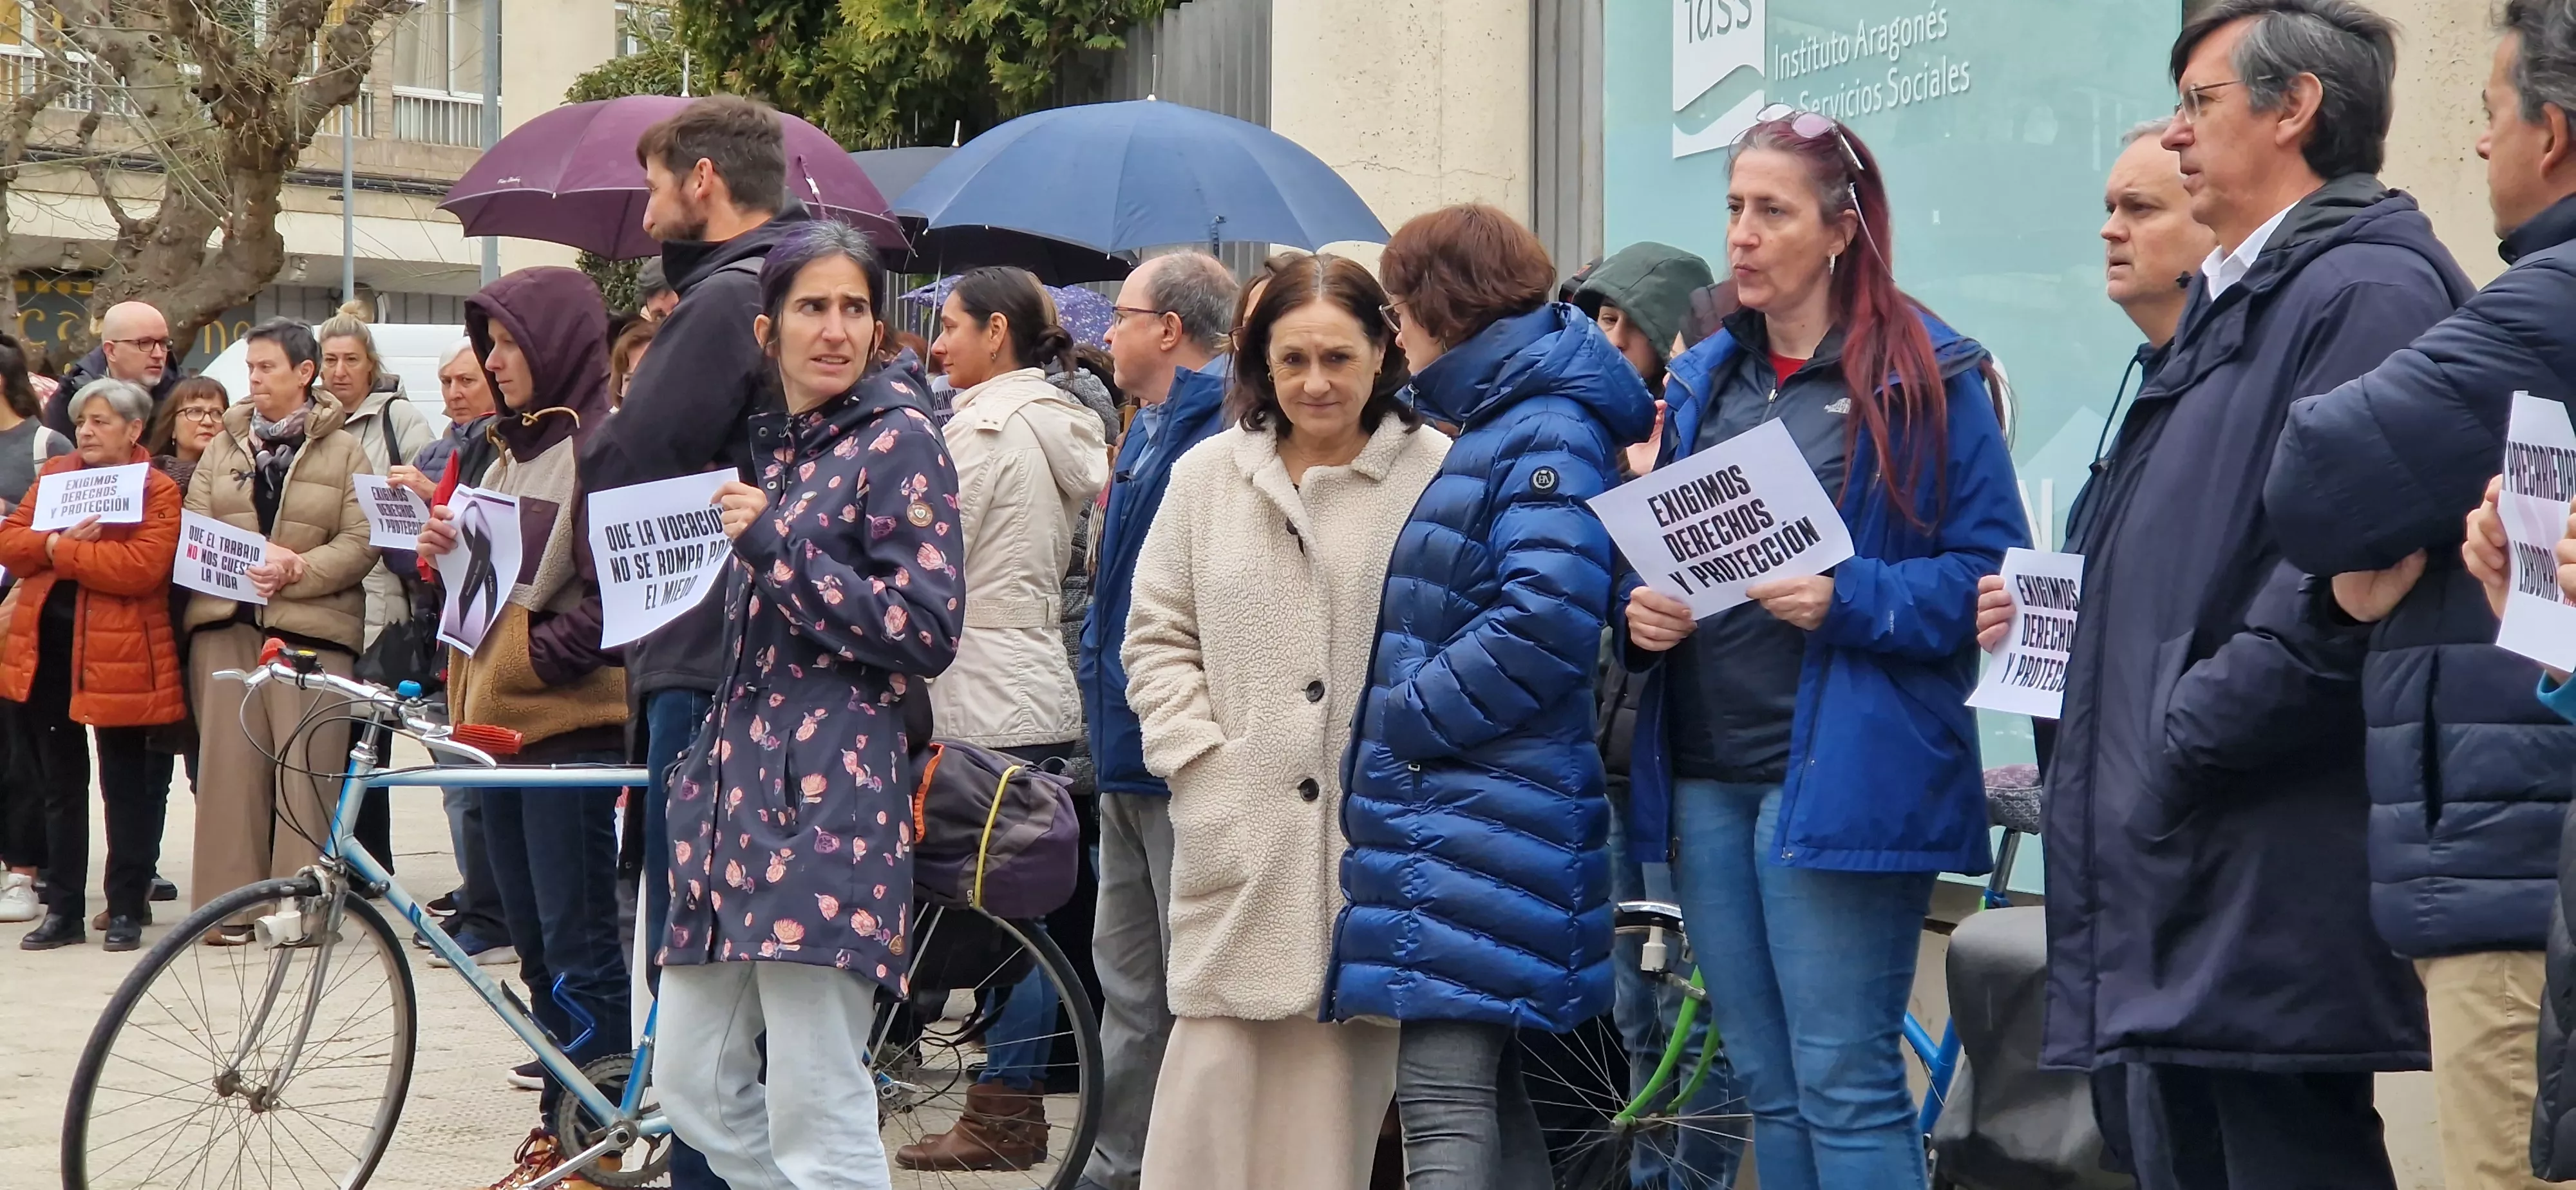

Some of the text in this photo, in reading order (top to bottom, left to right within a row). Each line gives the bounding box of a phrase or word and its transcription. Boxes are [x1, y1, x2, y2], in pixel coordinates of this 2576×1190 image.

[1775, 1, 1948, 81] Instituto Aragonés
[1886, 55, 1971, 108] Sociales
[61, 486, 117, 504] DERECHOS
[65, 474, 118, 491] EXIGIMOS
[371, 486, 409, 502] EXIGIMOS
[1647, 464, 1752, 528] EXIGIMOS
[50, 495, 129, 518] Y PROTECCIÓN
[376, 503, 416, 518] DERECHOS
[189, 525, 260, 563] QUE EL TRABAJO
[378, 518, 425, 536] Y PROTECCIÓ
[605, 504, 725, 552] QUE LA VOCACIÓ
[1662, 498, 1775, 563] DERECHOS
[186, 543, 256, 576] NO NOS CUEST
[610, 556, 631, 583] NO
[634, 552, 653, 580] SE
[656, 543, 704, 576] ROMPA
[1667, 515, 1822, 596] Y PROTECCIÓN
[2514, 540, 2559, 602] LABORAL
[201, 567, 238, 590] LA VIDA
[645, 574, 698, 610] EL MIEDO
[2016, 574, 2080, 612] EXIGIMOS
[2021, 612, 2074, 653] DERECHO
[2000, 652, 2016, 684] Y
